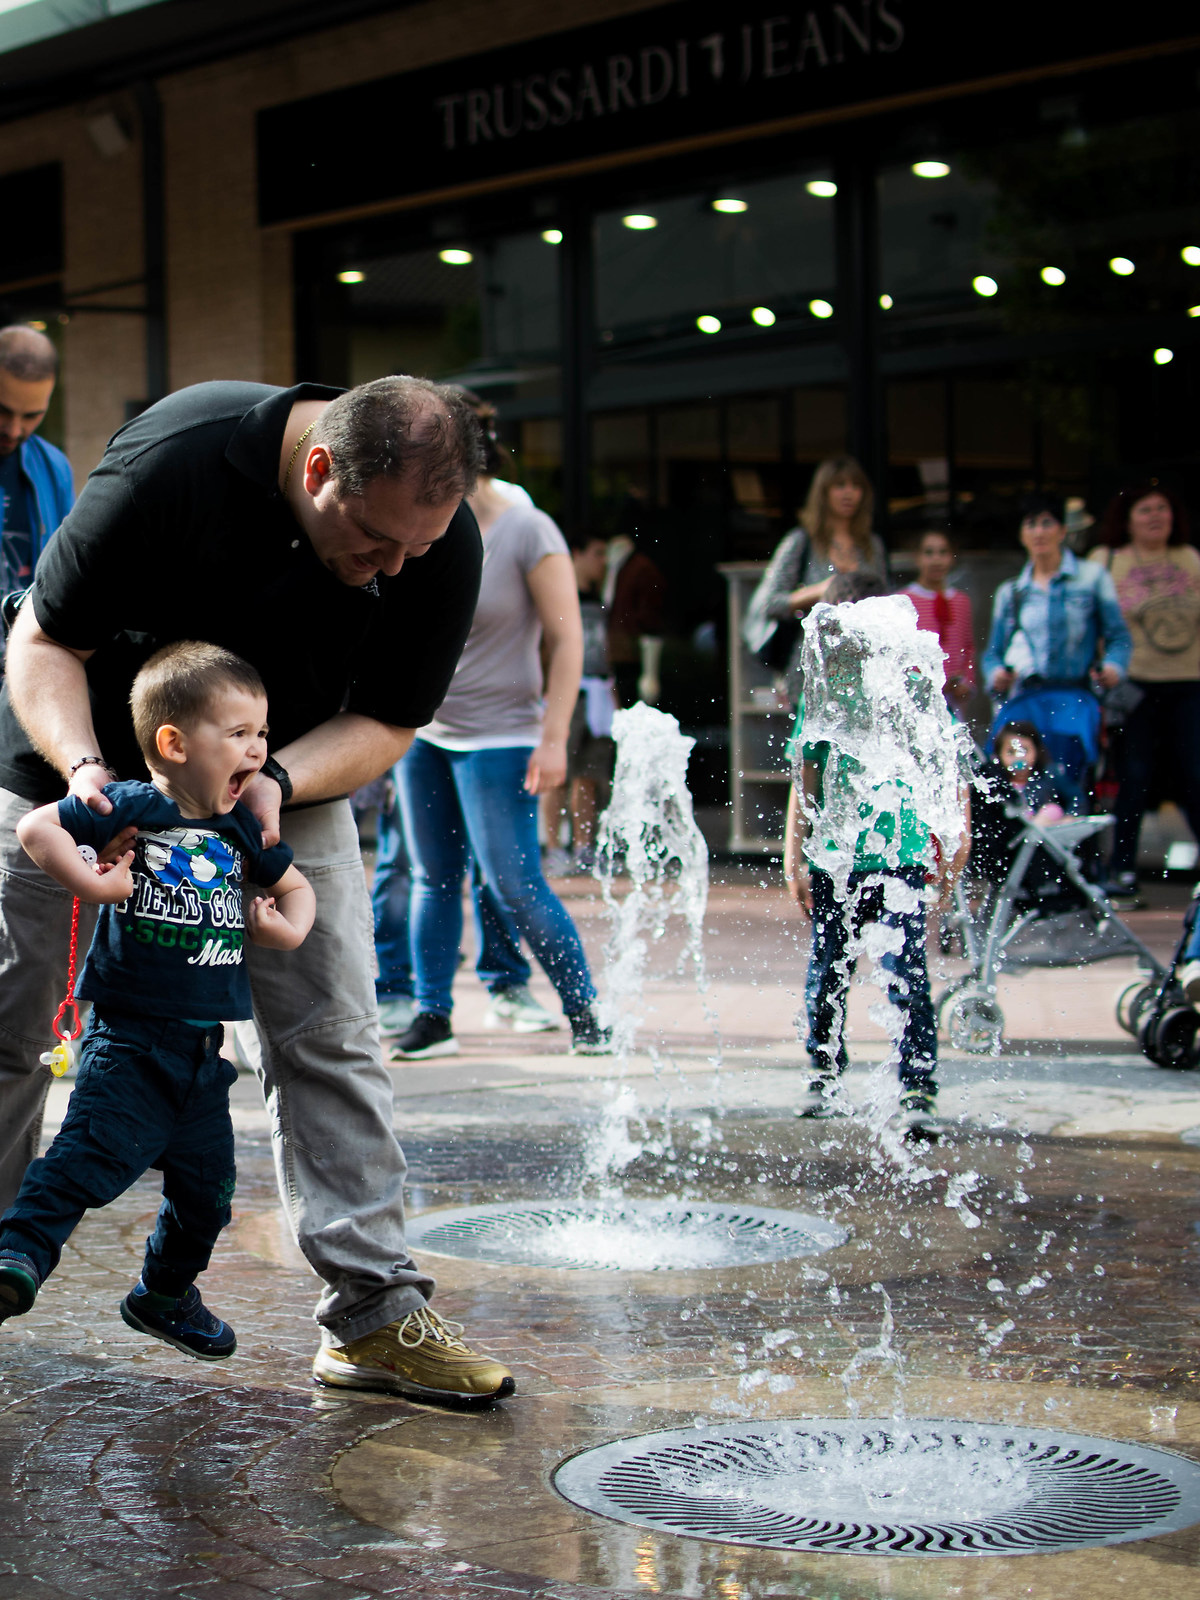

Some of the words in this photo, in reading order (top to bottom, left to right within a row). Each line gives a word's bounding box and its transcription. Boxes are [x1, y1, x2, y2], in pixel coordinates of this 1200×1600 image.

[432, 37, 690, 150] TRUSSARDI
[738, 0, 906, 87] JEANS
[134, 919, 244, 952] SOCCER
